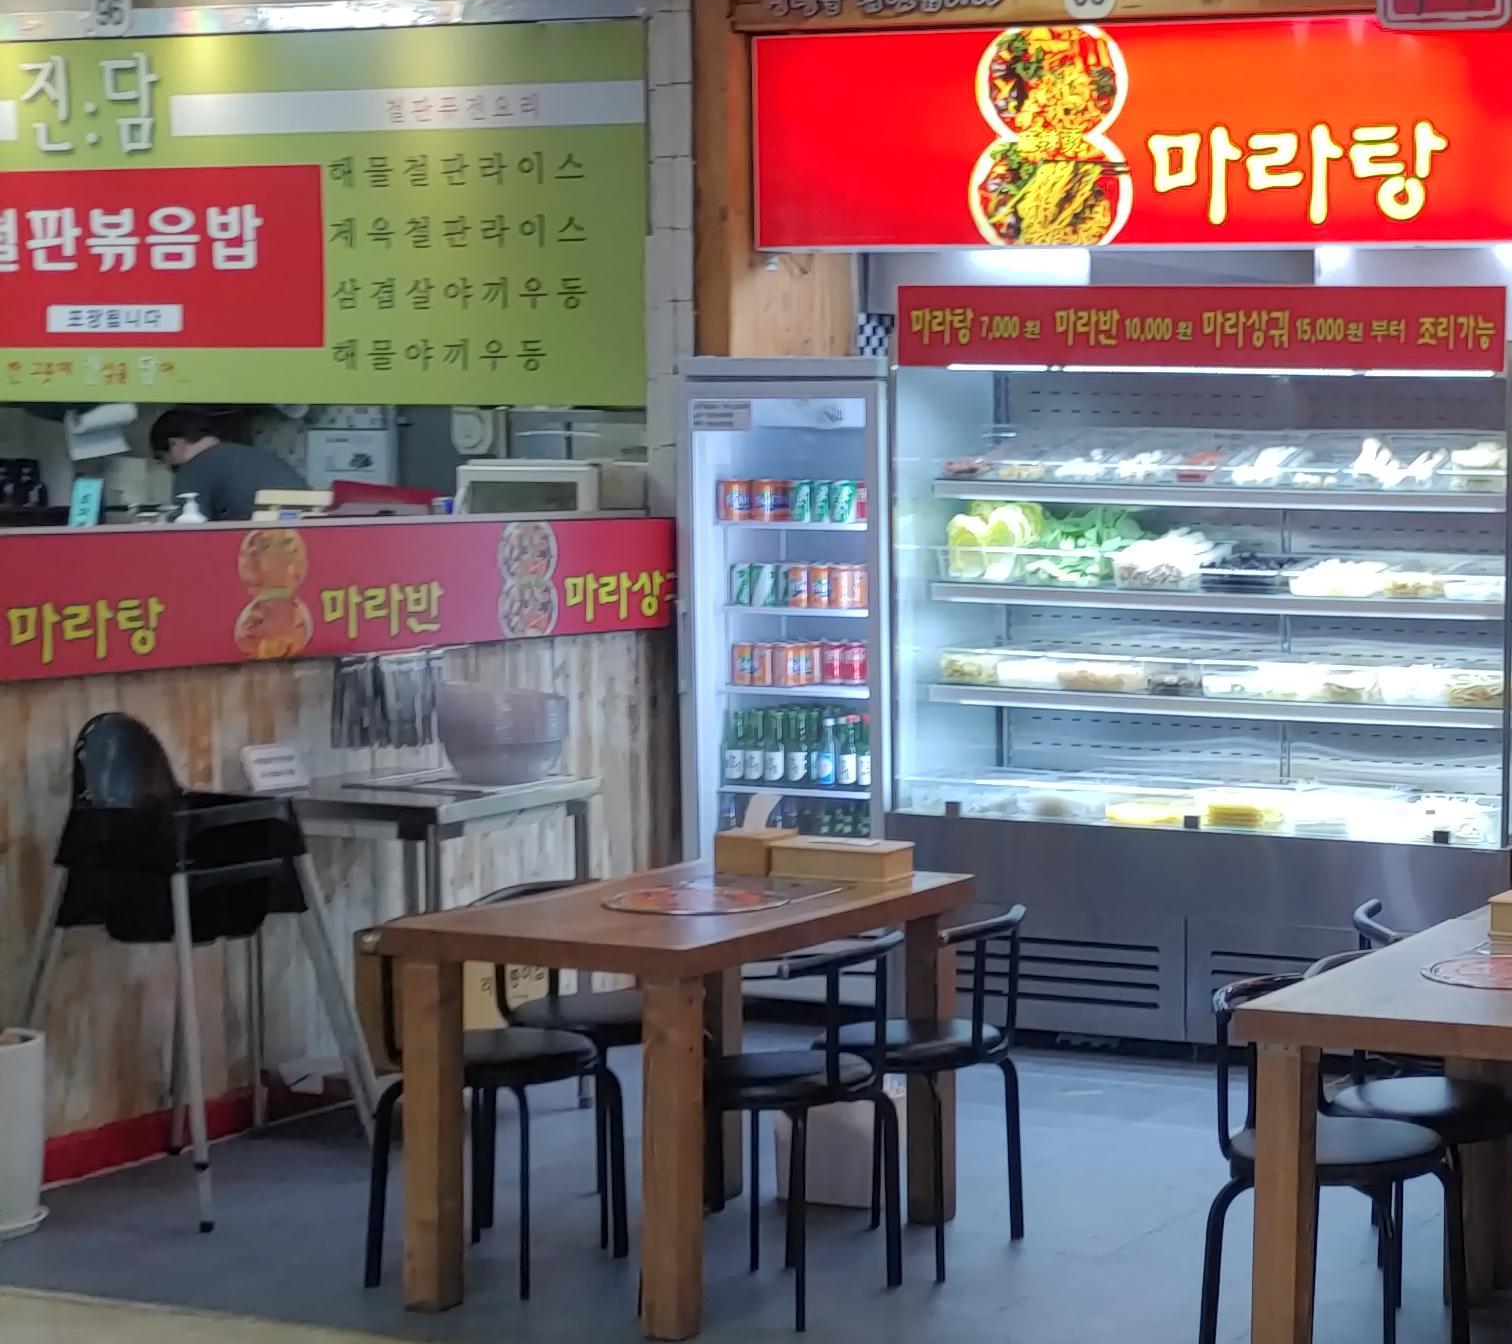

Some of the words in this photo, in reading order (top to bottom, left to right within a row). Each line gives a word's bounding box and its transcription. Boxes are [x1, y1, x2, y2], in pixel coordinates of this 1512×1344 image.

[1147, 120, 1449, 226] 마라탕
[910, 308, 973, 346] 마라탕
[979, 315, 1020, 340] 7,000
[1023, 319, 1041, 340] 원
[1055, 308, 1120, 346] 마라반
[1124, 317, 1172, 341] 10,000
[1175, 321, 1193, 341] 원
[1370, 319, 1406, 343] 부터
[1416, 314, 1497, 350] 조리가능
[6, 596, 166, 665] 마라탕
[320, 581, 445, 640] 마라반
